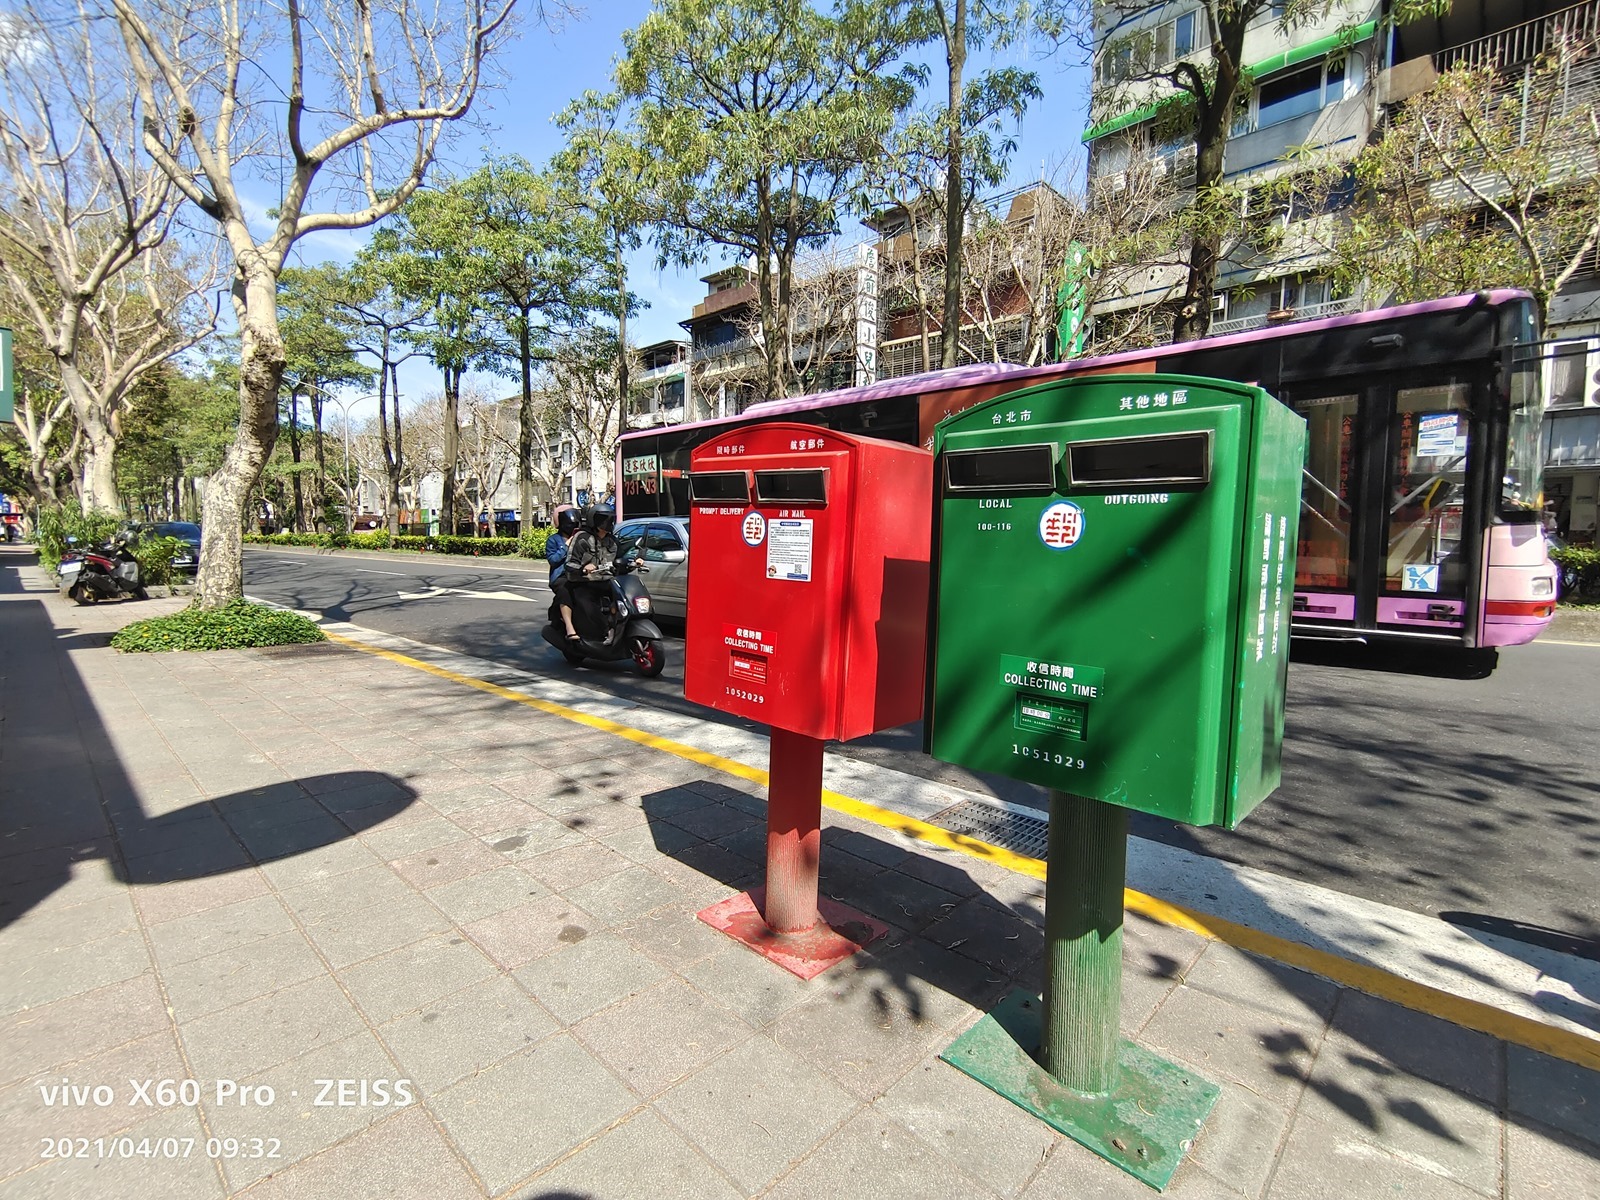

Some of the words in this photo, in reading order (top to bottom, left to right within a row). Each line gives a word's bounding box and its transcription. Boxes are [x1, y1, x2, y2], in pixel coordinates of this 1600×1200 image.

[1119, 389, 1188, 411] 其他地區
[992, 410, 1032, 425] 台北市
[717, 445, 746, 455] 限時郵件
[790, 438, 825, 451] 航空郵件
[979, 499, 1013, 509] LOCAL
[1104, 493, 1169, 505] OUTGOING
[699, 507, 719, 515] PROMPT
[720, 507, 745, 515] DELIVERY
[779, 510, 789, 518] AIR
[791, 510, 806, 518] MAIL
[977, 523, 1012, 531] 100-116
[736, 628, 762, 641] 收信時間
[724, 637, 758, 651] COLLECTING
[760, 643, 774, 654] TIME
[1026, 661, 1075, 679] 收信時間
[1004, 673, 1067, 693] COLLECTING
[1071, 683, 1098, 698] TIME
[726, 686, 765, 704] 1052029
[1012, 743, 1085, 770] 1051029
